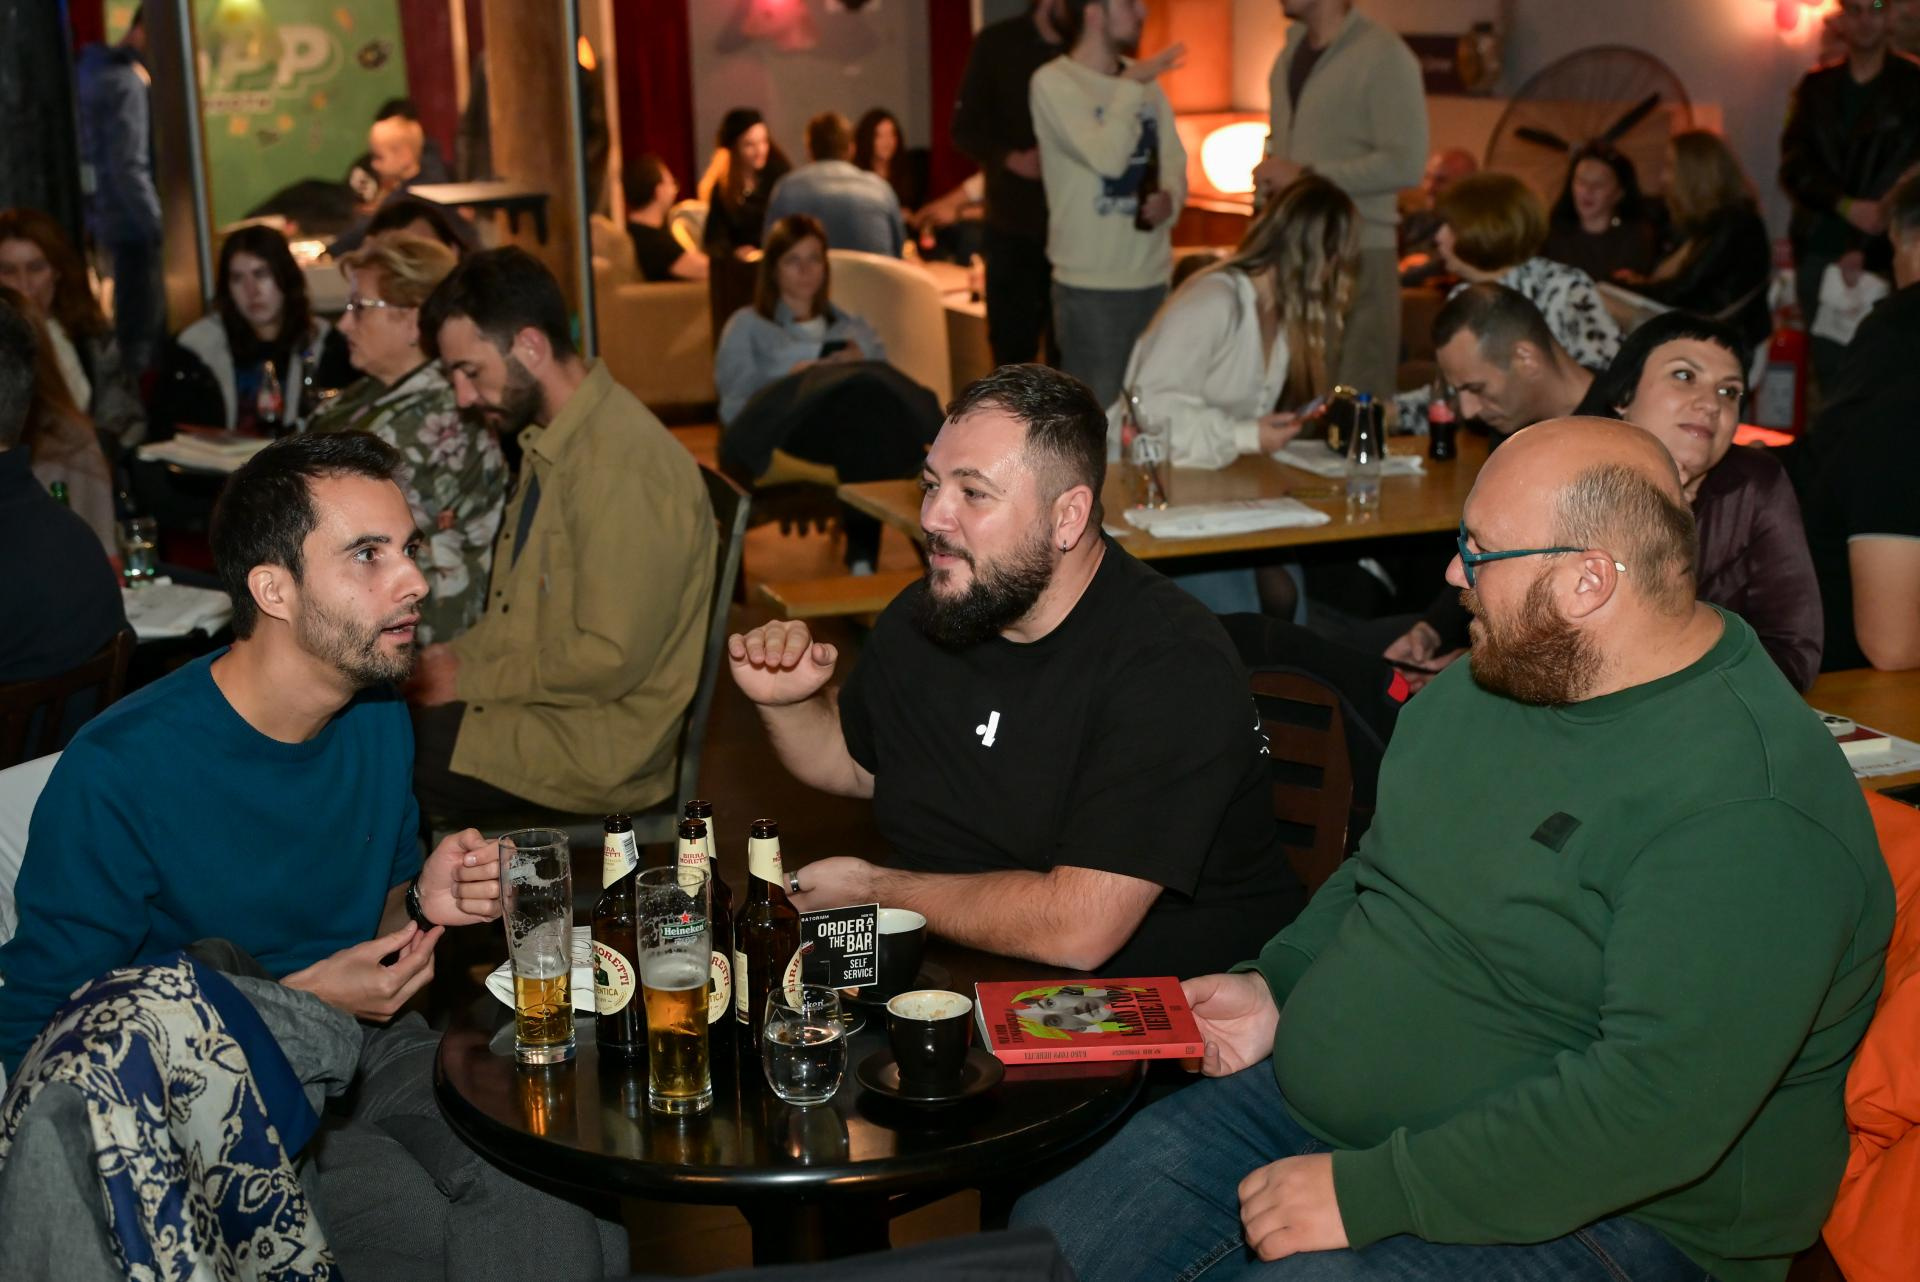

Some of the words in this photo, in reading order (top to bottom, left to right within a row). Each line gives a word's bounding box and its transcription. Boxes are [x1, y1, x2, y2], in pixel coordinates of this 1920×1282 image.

[663, 924, 705, 936] Heineken
[817, 918, 865, 938] ORDER
[829, 935, 846, 948] THE
[846, 932, 873, 953] BAR
[849, 957, 868, 969] SELF
[843, 967, 874, 980] SERVICE
